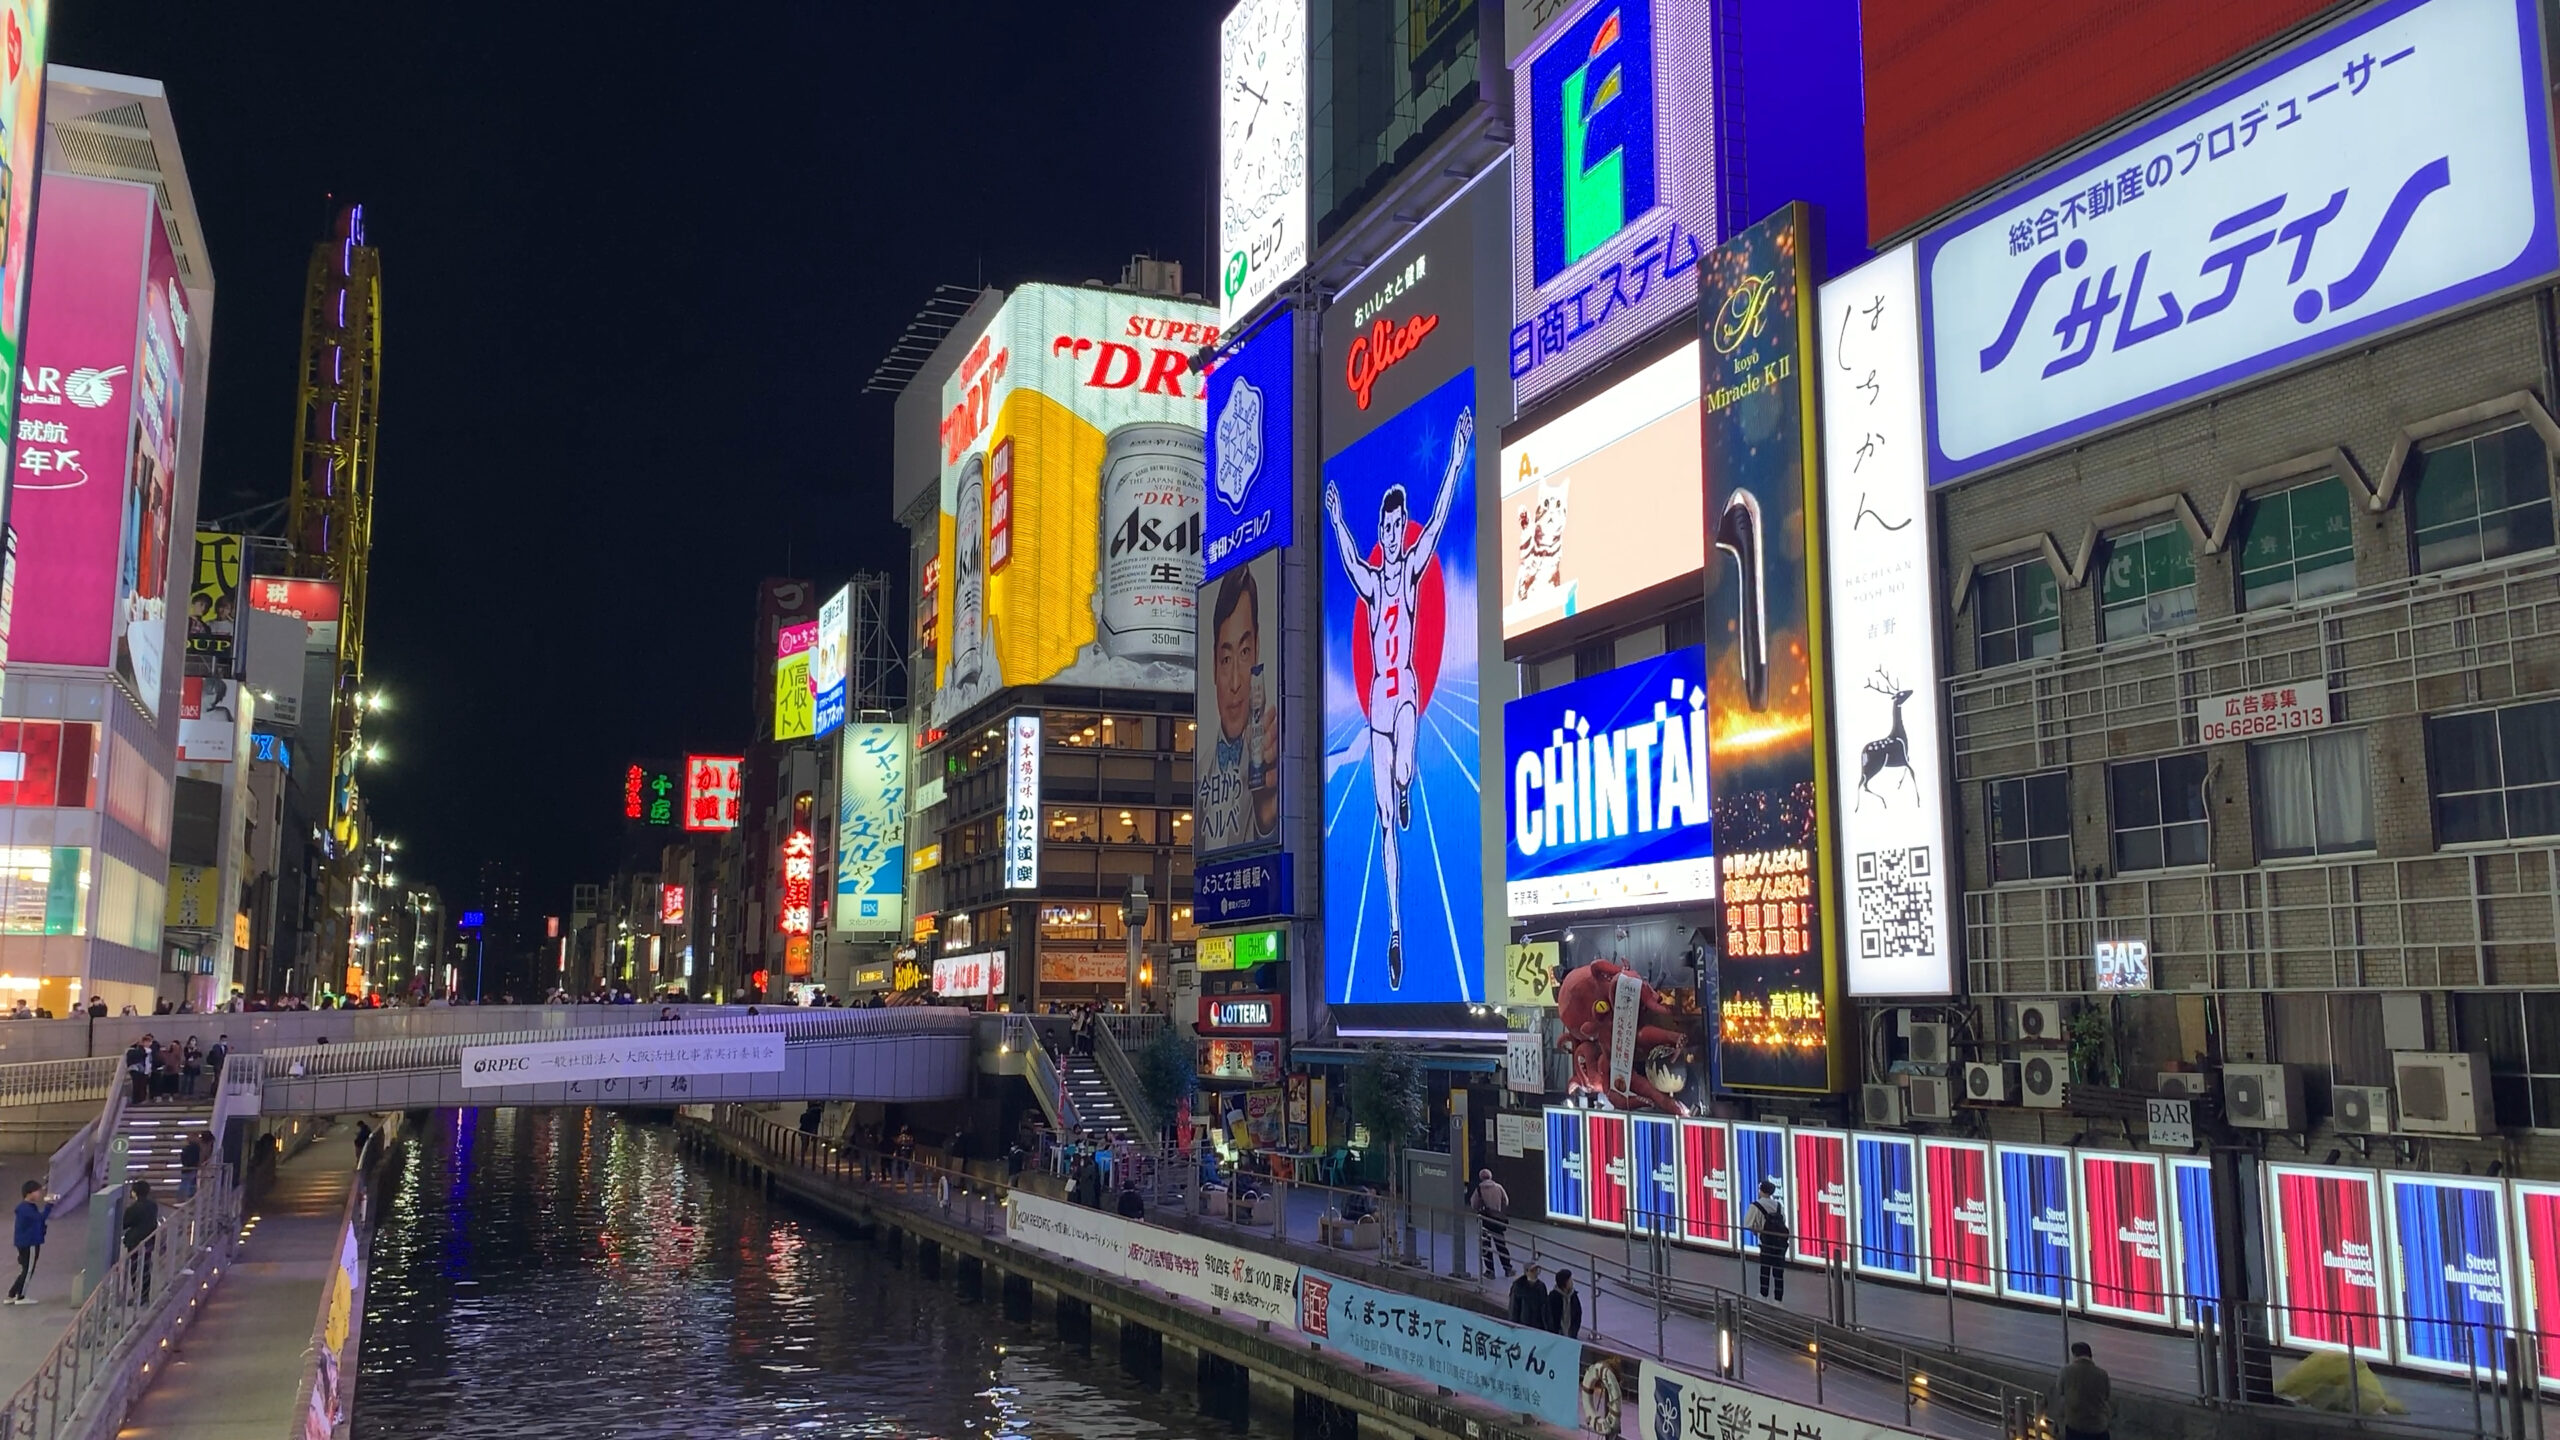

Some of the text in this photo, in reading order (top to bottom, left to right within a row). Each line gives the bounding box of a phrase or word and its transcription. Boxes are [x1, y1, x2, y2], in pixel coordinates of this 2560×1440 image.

[2008, 45, 2416, 258] 総合不動産のプロデューサー
[1354, 254, 1427, 328] おいしさと健康
[1509, 223, 1698, 381] 日商エステム
[1125, 315, 1223, 347] SUPER
[1346, 315, 1439, 410] Glico
[1706, 374, 1761, 414] Miracle
[1764, 361, 1777, 387] K
[1838, 295, 1912, 531] はちかん
[1208, 510, 1271, 565] 雪印メグミルク
[1150, 563, 1183, 585] 生
[266, 583, 288, 603] 税
[1134, 595, 1195, 608] スーパードラ
[1152, 634, 1180, 645] 350ml
[1384, 598, 1401, 698] グリコ
[780, 665, 795, 735] バイト
[794, 663, 809, 732] 高収入
[2225, 688, 2297, 718] 広告募集
[2203, 707, 2323, 741] 06-6262-1313
[1020, 744, 1034, 798] 本場の味
[860, 727, 904, 846] シャッターは
[1199, 769, 1242, 808] 今日から
[1202, 806, 1240, 839] ヘルベ
[1017, 804, 1034, 882] かに道楽
[1203, 866, 1271, 895] ようこそ道頓堀へ
[849, 918, 891, 927] 文化シャッター
[862, 904, 878, 915] BX
[1727, 901, 1808, 930] 中国加油!
[1728, 928, 1809, 956] 武汉加油!
[2096, 942, 2148, 974] BAR
[2100, 973, 2147, 988] ふたごや
[1221, 1003, 1267, 1024] LOTTERIA
[1722, 990, 1820, 1019] 株式会社 高陽社
[541, 1045, 775, 1068] 一般社団法人 大阪活性化事業実行委員会
[2149, 1103, 2190, 1125] BAR
[2152, 1130, 2189, 1142] ふたごや
[2134, 1216, 2156, 1233] Street
[2341, 1239, 2370, 1257] Street
[2465, 1253, 2497, 1274] Street
